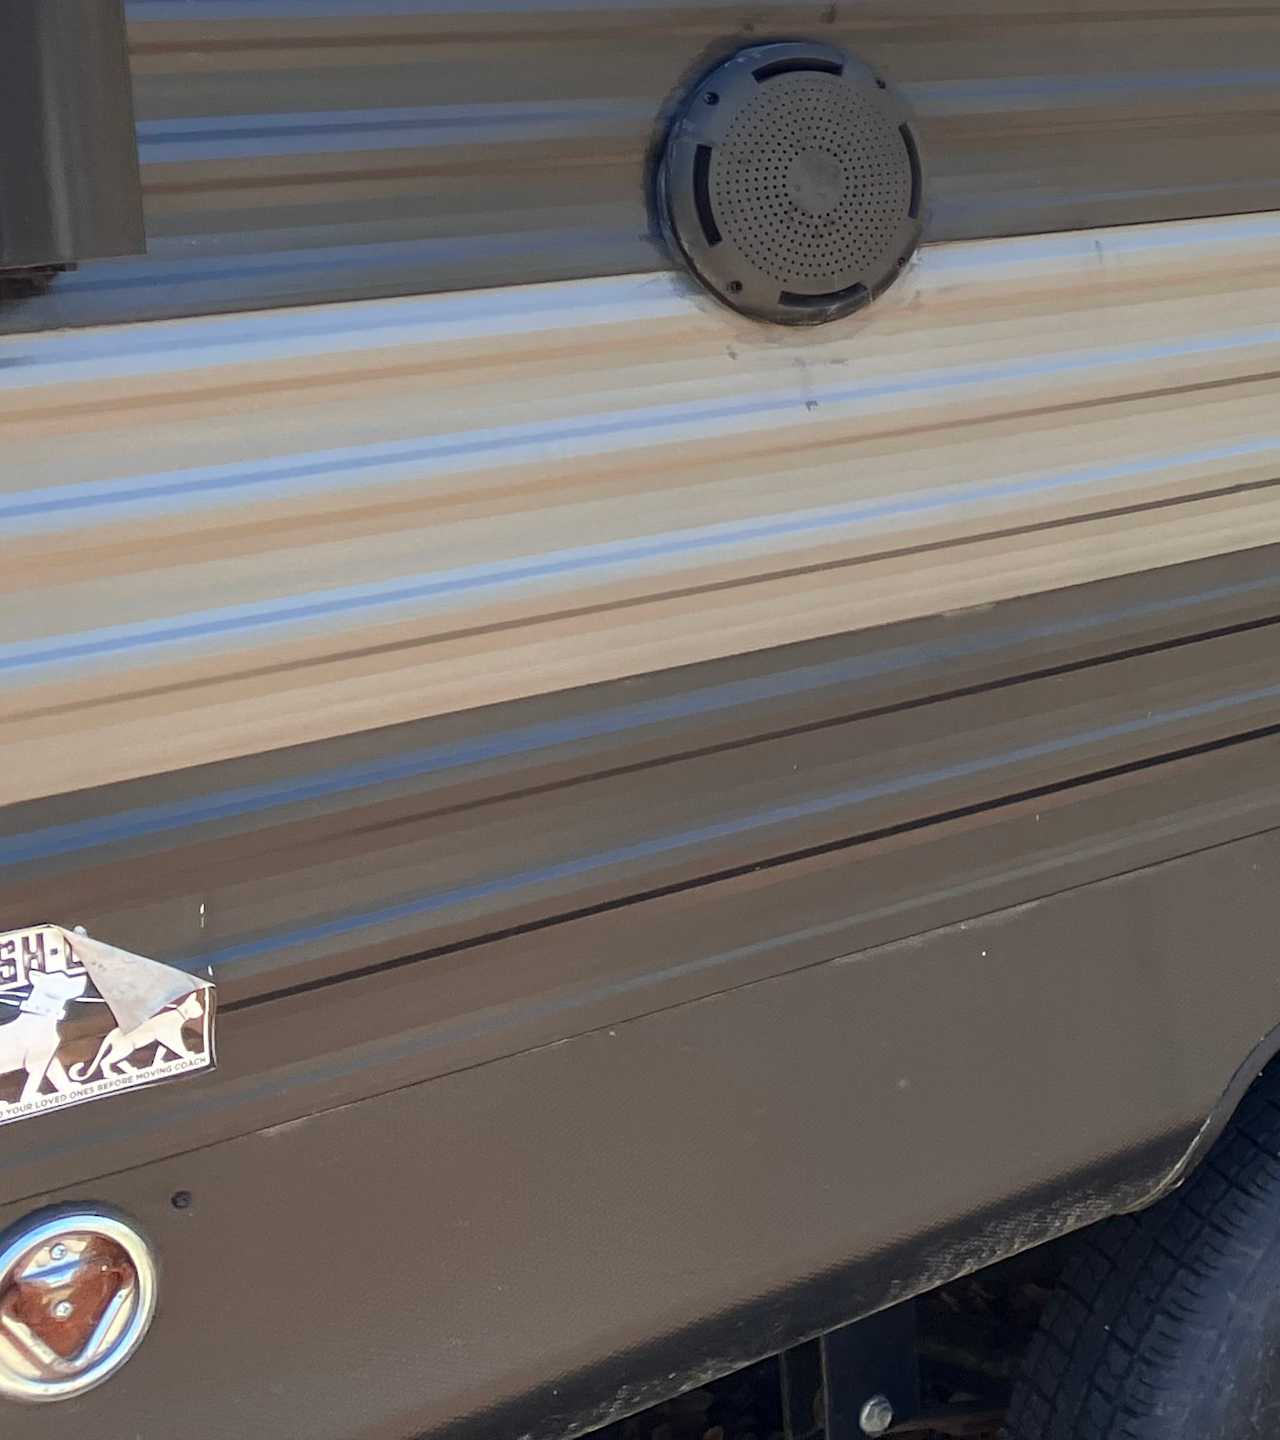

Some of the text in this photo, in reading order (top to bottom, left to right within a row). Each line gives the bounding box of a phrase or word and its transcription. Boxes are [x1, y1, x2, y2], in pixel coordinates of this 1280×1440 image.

[6, 1103, 33, 1116] YOUR
[35, 1094, 67, 1109] LOVED
[69, 1086, 95, 1100] ONES
[97, 1076, 134, 1091] BEFORE
[136, 1067, 172, 1081] MOVING
[175, 1058, 206, 1070] COACH
